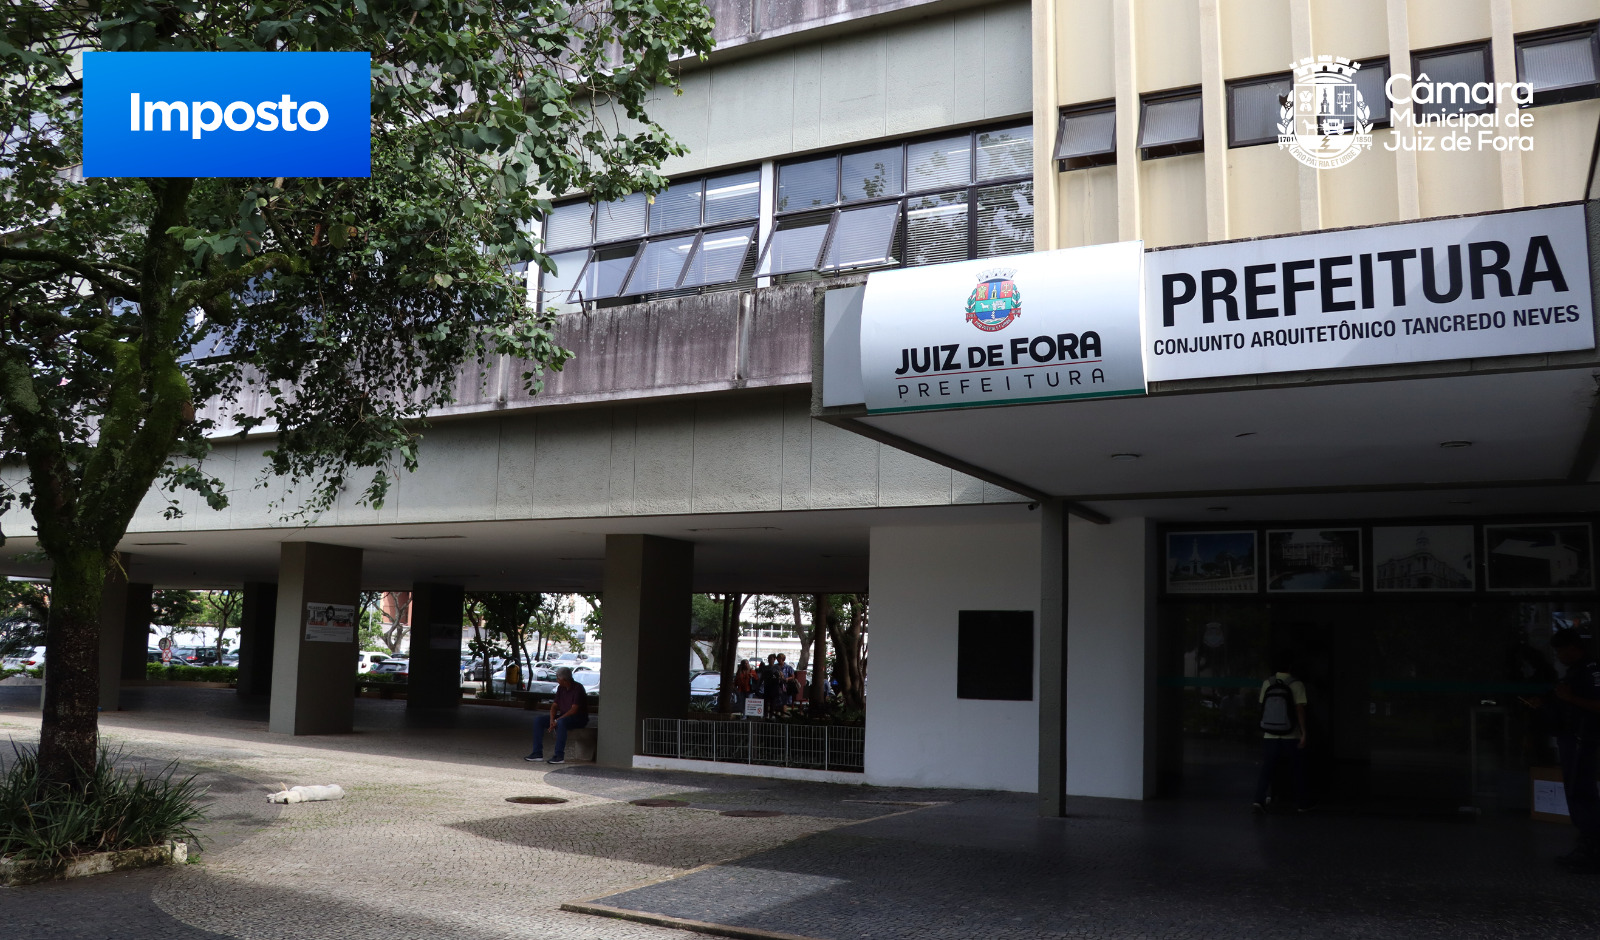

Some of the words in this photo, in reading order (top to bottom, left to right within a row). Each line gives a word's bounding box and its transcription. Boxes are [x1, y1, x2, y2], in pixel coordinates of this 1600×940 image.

[1161, 234, 1569, 328] PREFEITURA
[895, 344, 961, 375] JUIZ
[967, 345, 1004, 368] DE
[1010, 331, 1102, 365] FORA
[1153, 333, 1245, 356] CONJUNTO
[1250, 320, 1396, 348] ARQUITETÔNICO
[1402, 310, 1506, 336] TANCREDO
[1513, 304, 1580, 327] NEVES
[898, 368, 1105, 399] PREFEITURA
